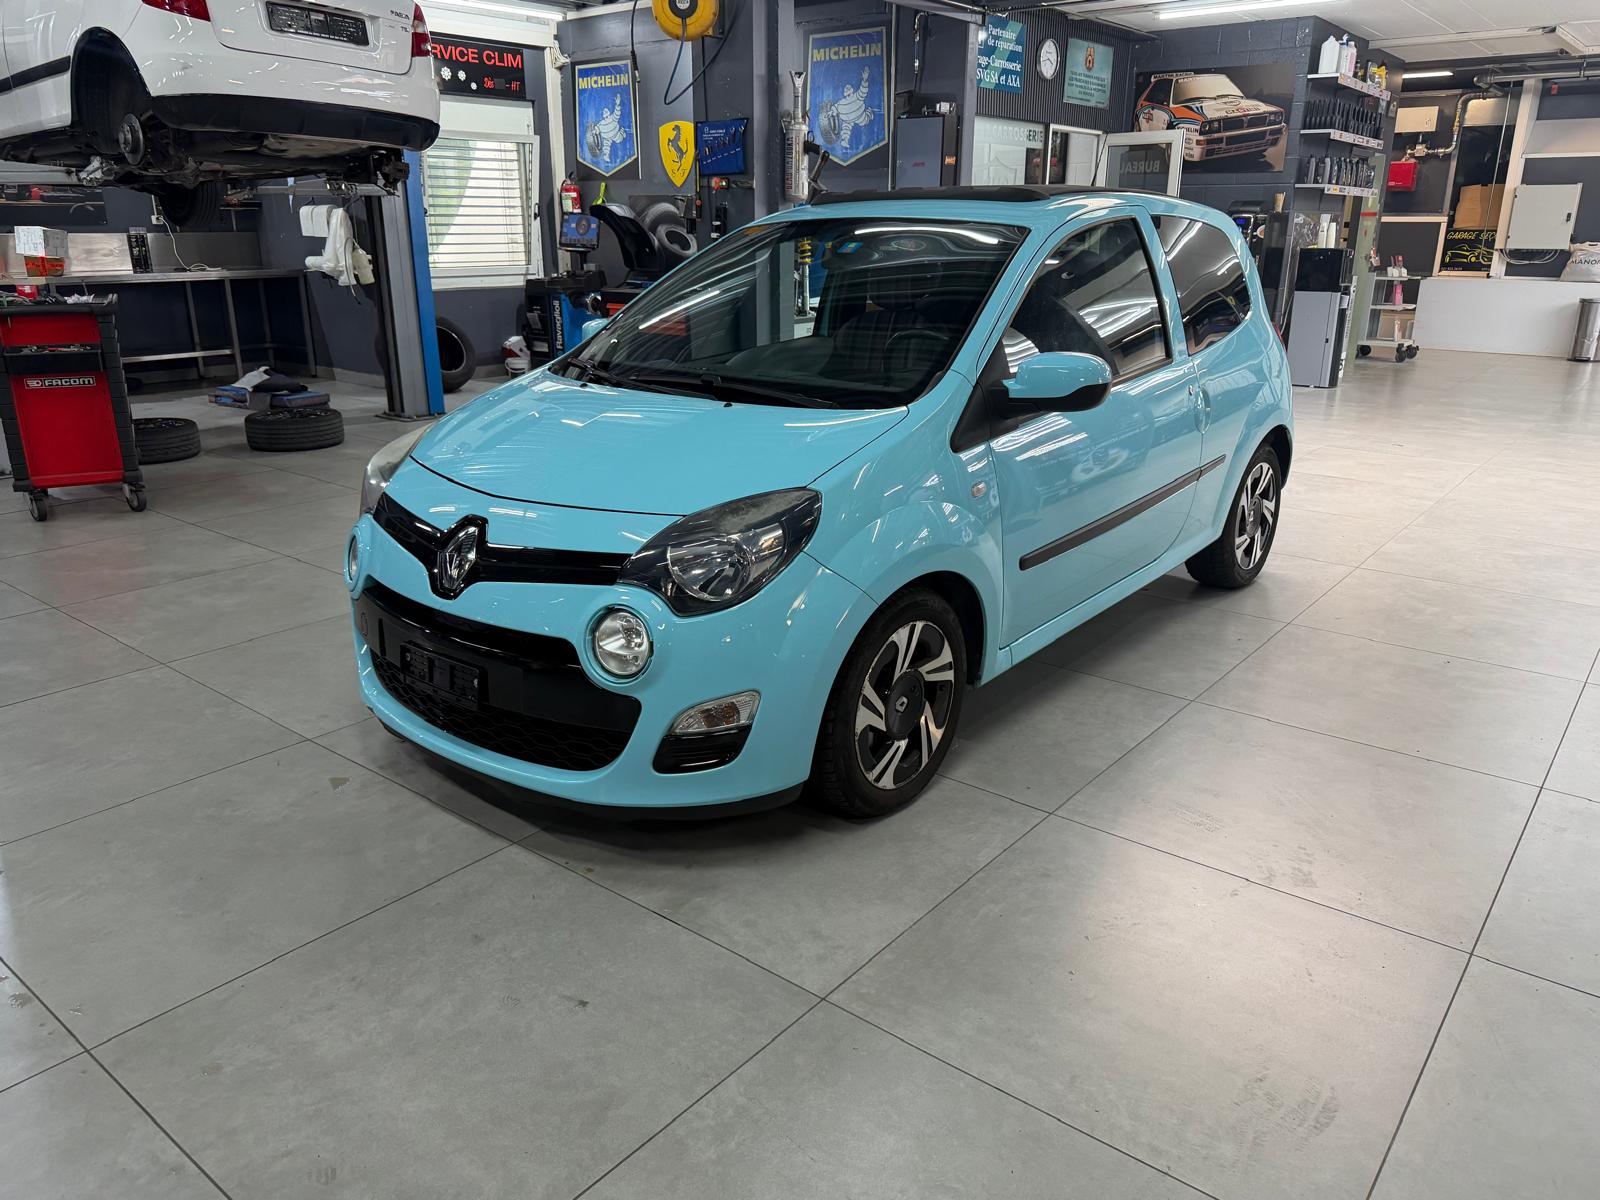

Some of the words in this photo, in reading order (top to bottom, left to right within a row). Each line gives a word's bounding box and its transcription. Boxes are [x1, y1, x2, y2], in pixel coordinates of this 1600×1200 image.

[988, 24, 1016, 40] Partenaire
[812, 42, 881, 62] MICHELIN
[987, 35, 995, 47] de
[995, 38, 1022, 53] réparation
[431, 43, 479, 64] RVICE
[483, 50, 521, 69] CLIM
[578, 73, 629, 89] MICHELIN
[999, 74, 1006, 85] et
[1006, 74, 1021, 88] AXA
[1446, 231, 1479, 240] GARAGE
[552, 300, 563, 350] Ravaglioli
[45, 378, 94, 386] FACOM
